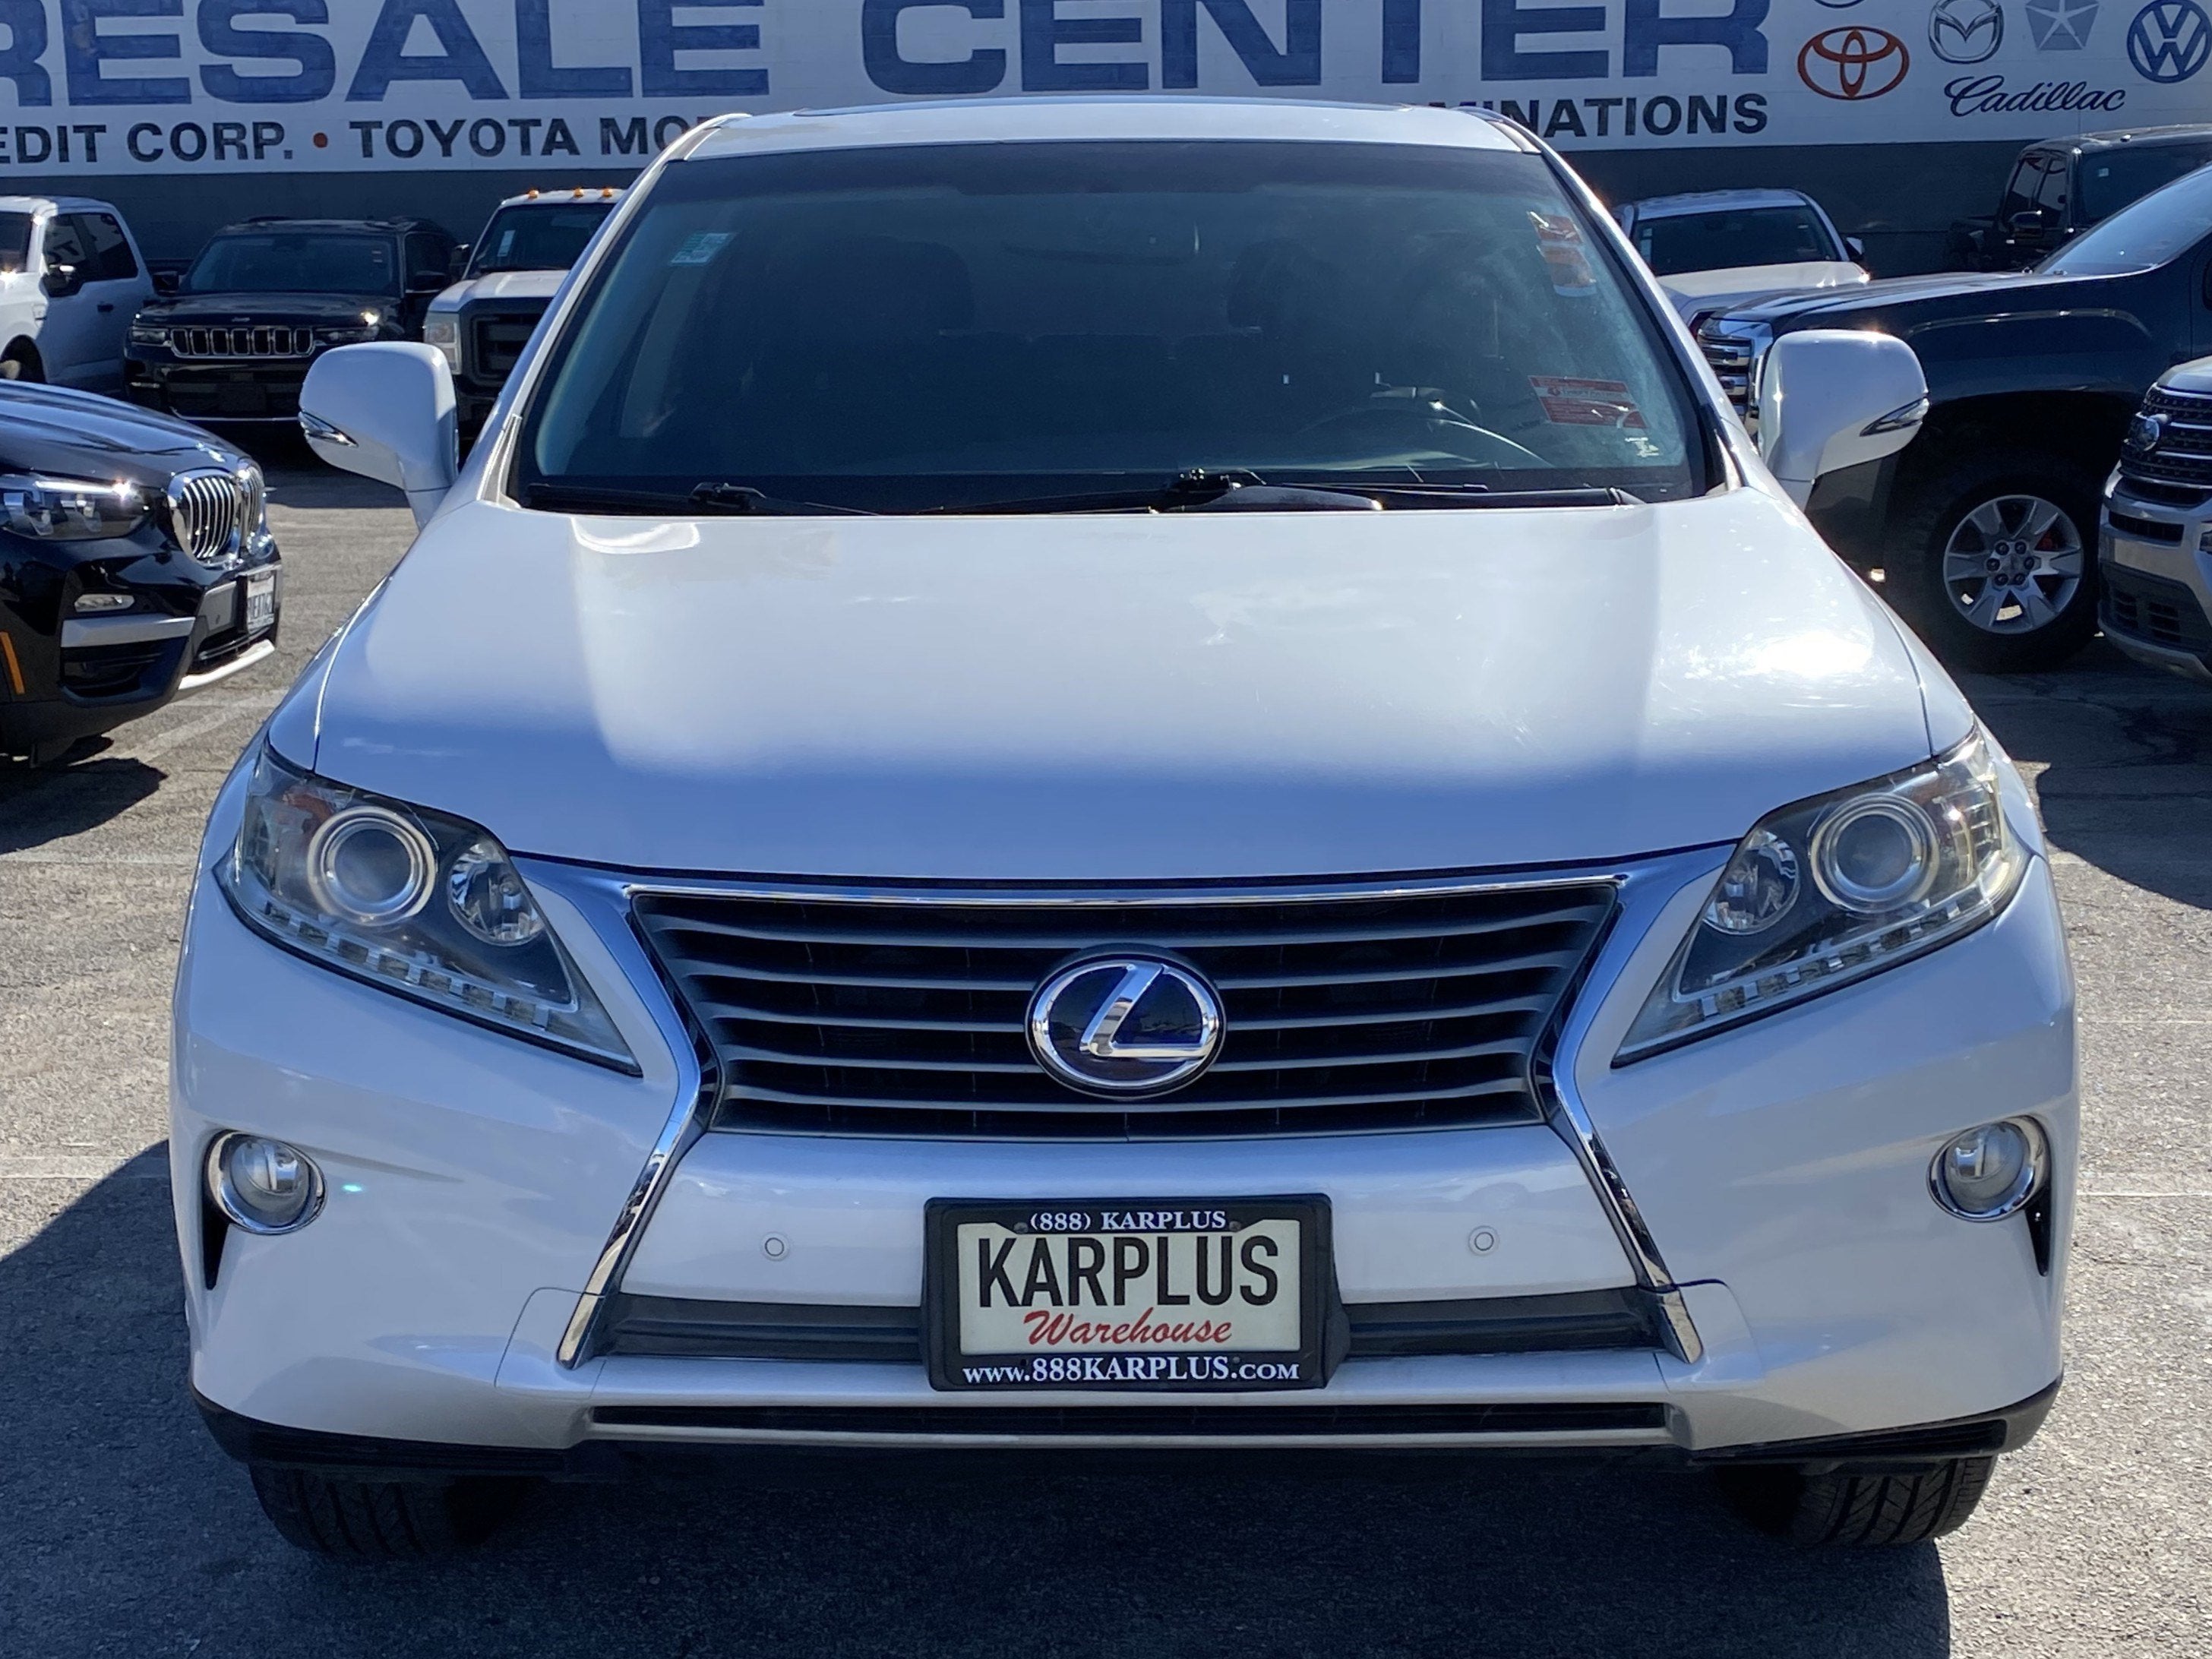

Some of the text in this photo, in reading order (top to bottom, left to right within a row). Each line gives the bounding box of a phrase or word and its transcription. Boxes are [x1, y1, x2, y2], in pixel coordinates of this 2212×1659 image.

[861, 0, 1768, 94] CENTER
[1944, 75, 2127, 117] Cadillac
[127, 122, 293, 162] CORP.
[349, 118, 580, 160] TOYOTA
[599, 115, 712, 155] MO
[1029, 1211, 1226, 1232] (888) KARPLUS
[978, 1234, 1279, 1308] KARPLUS
[1022, 1307, 1233, 1345] Warehouse
